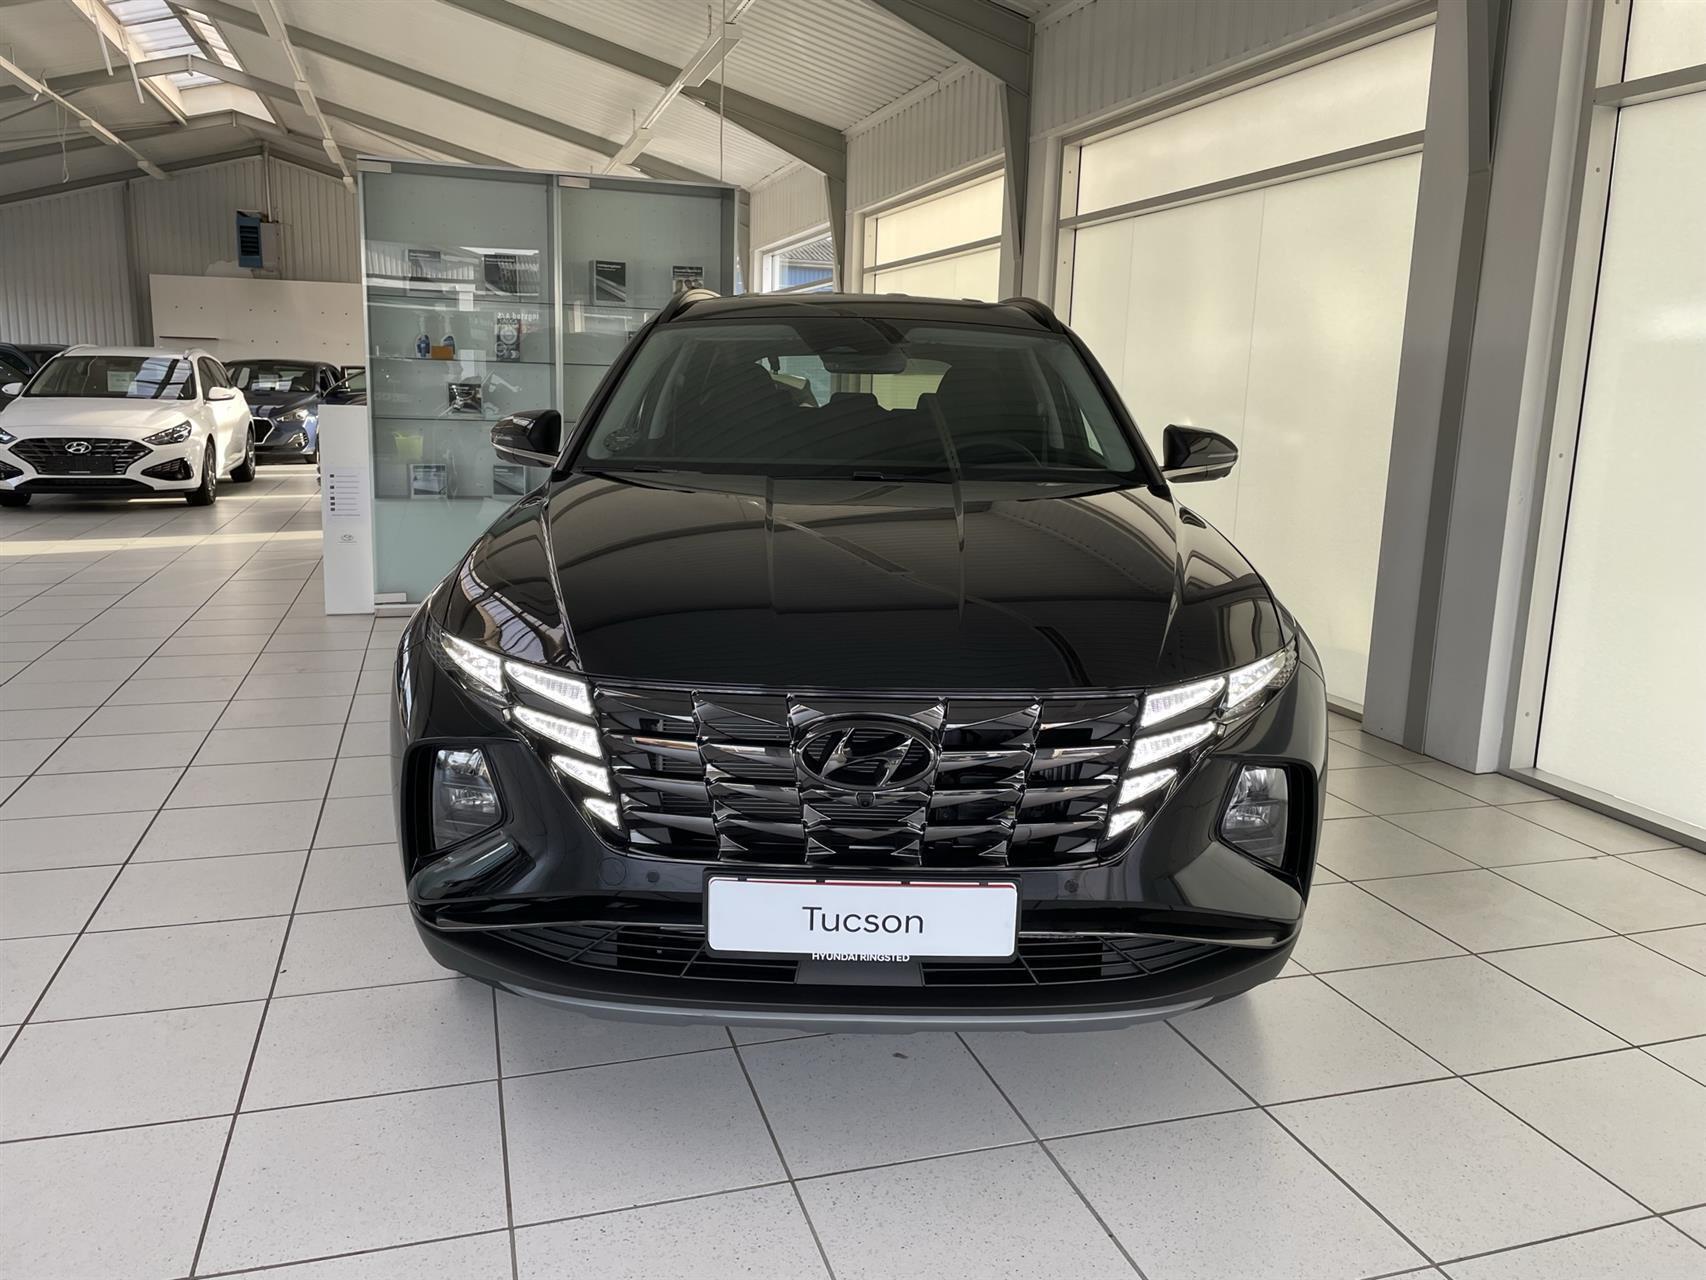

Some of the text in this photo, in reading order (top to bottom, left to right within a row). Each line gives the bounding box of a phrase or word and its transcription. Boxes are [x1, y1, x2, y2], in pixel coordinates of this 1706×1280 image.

[802, 906, 924, 934] Tucson
[811, 952, 910, 962] HYUNDAI RINGSTED
